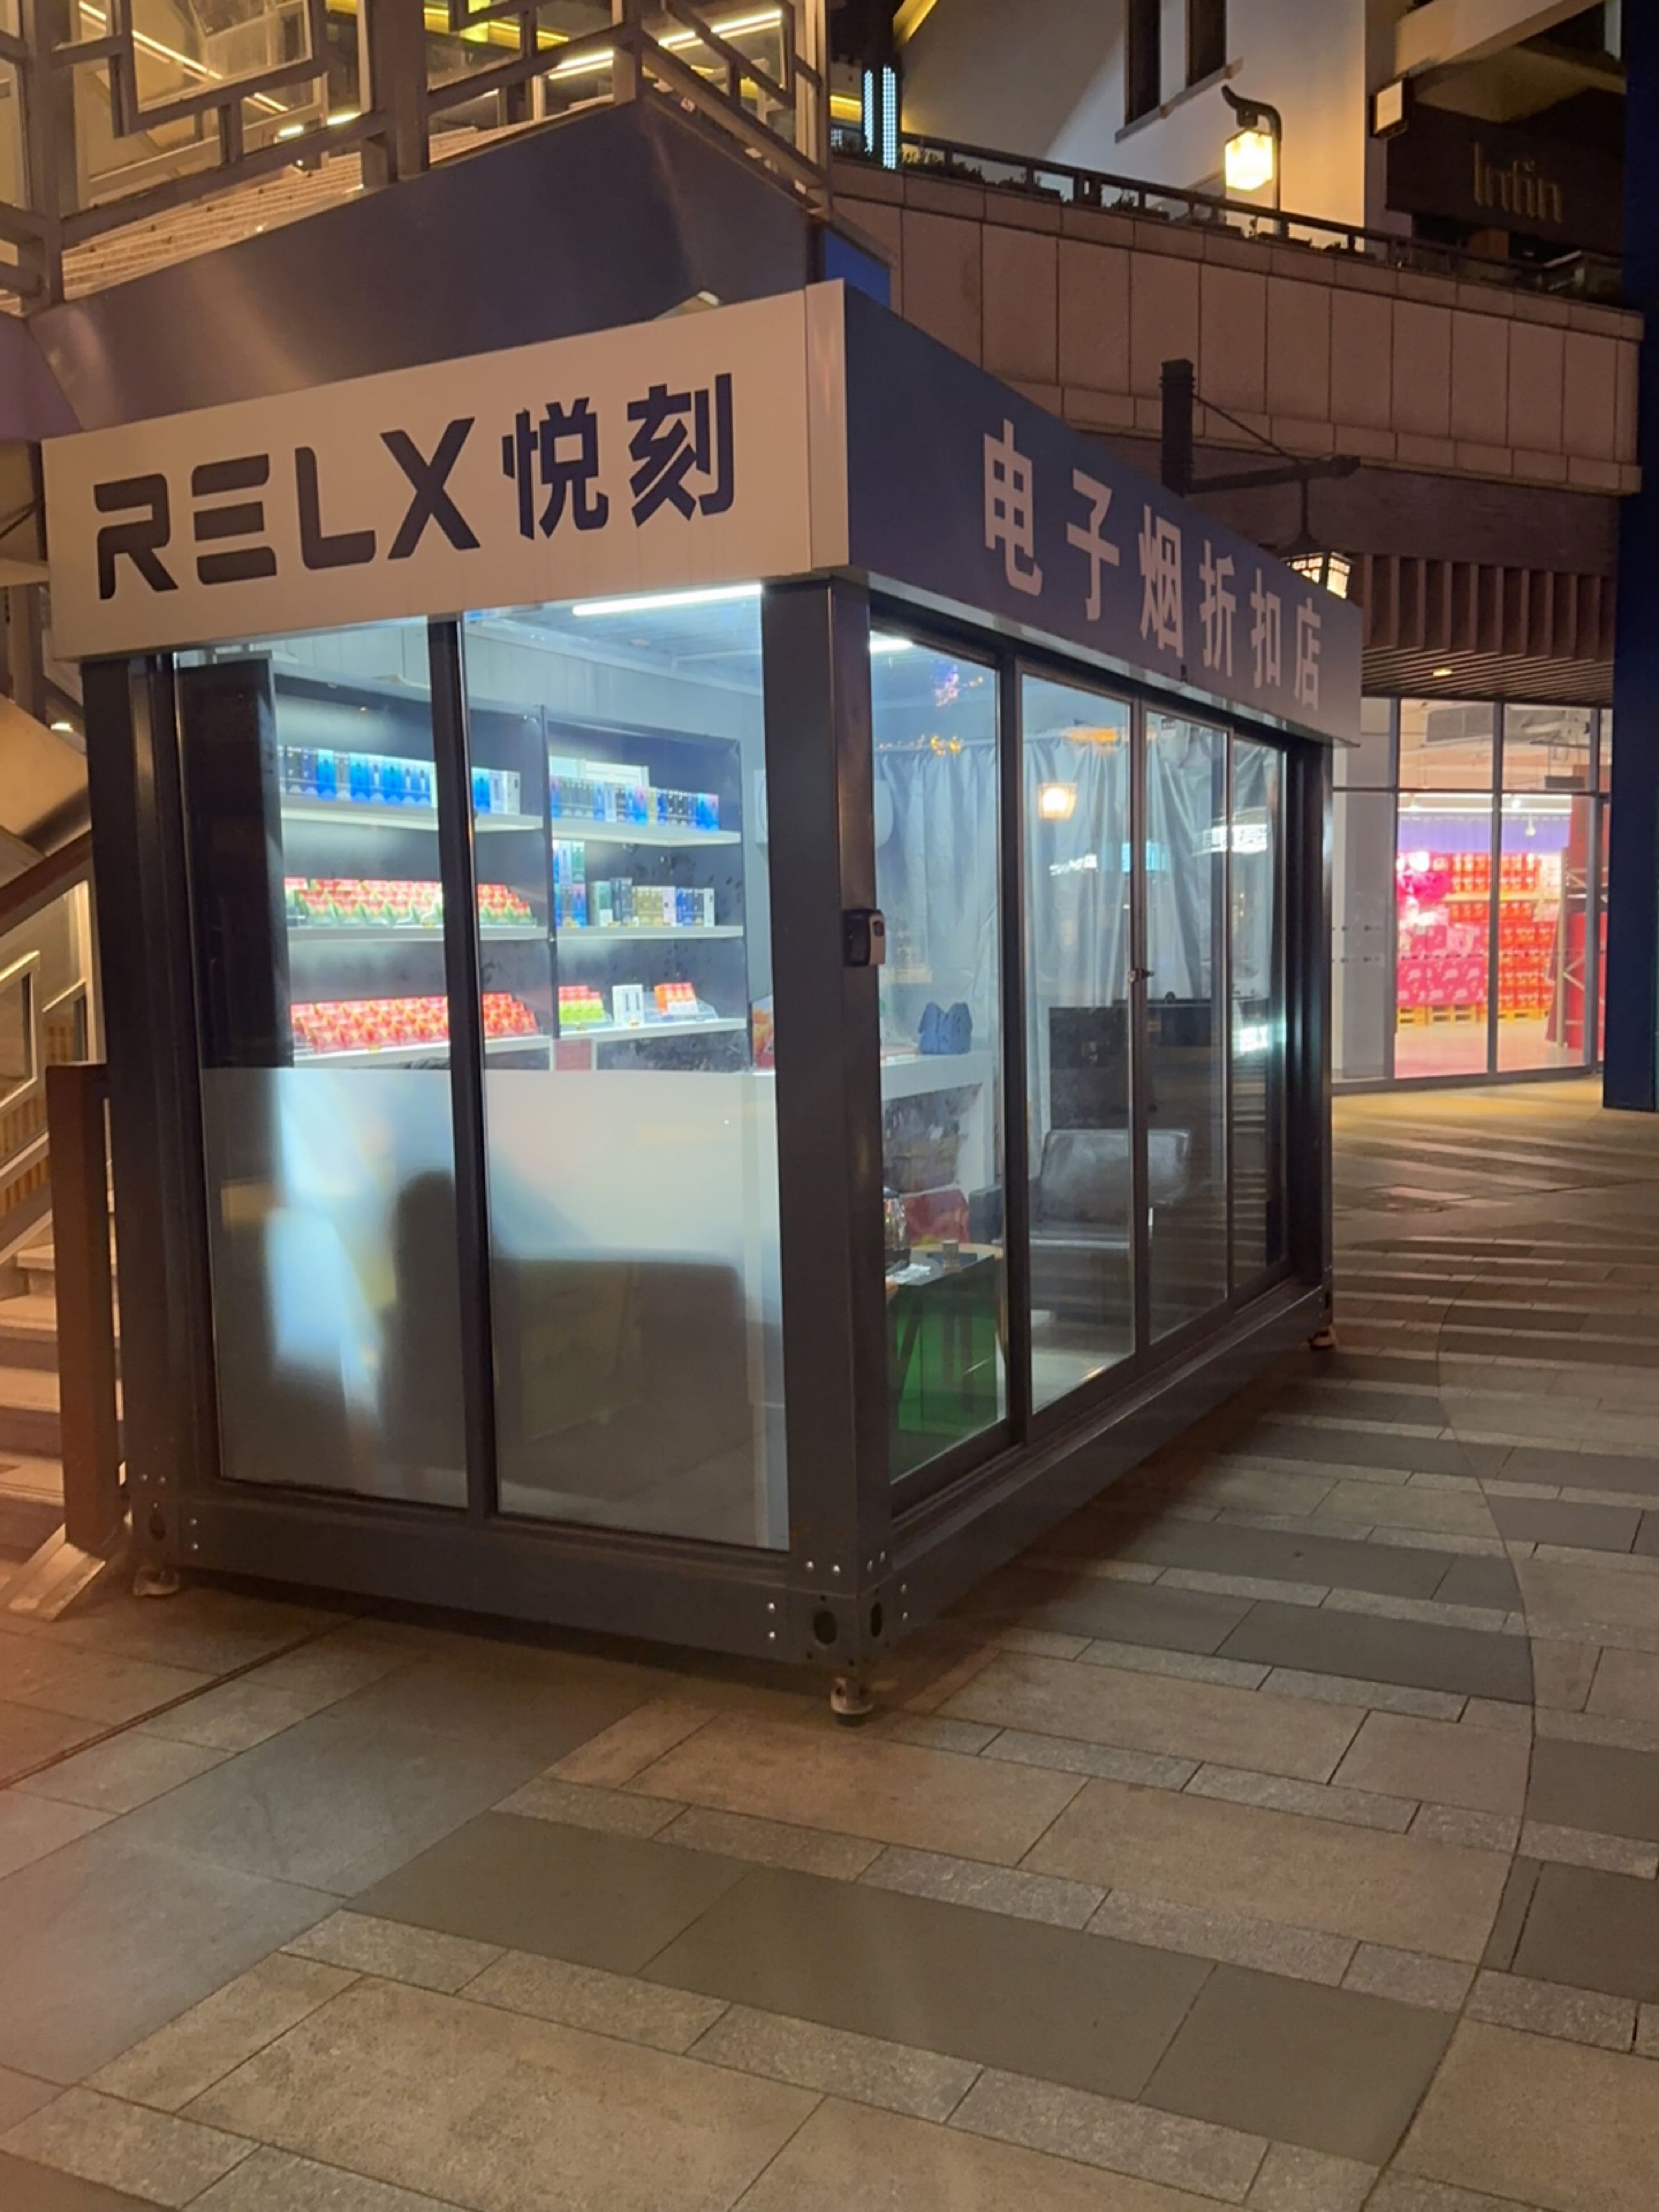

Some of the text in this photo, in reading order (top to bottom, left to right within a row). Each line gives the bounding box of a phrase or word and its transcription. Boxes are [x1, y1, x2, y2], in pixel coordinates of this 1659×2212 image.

[92, 372, 735, 601] RELX 悦刻
[983, 418, 1322, 710] 电子烟折扣店
